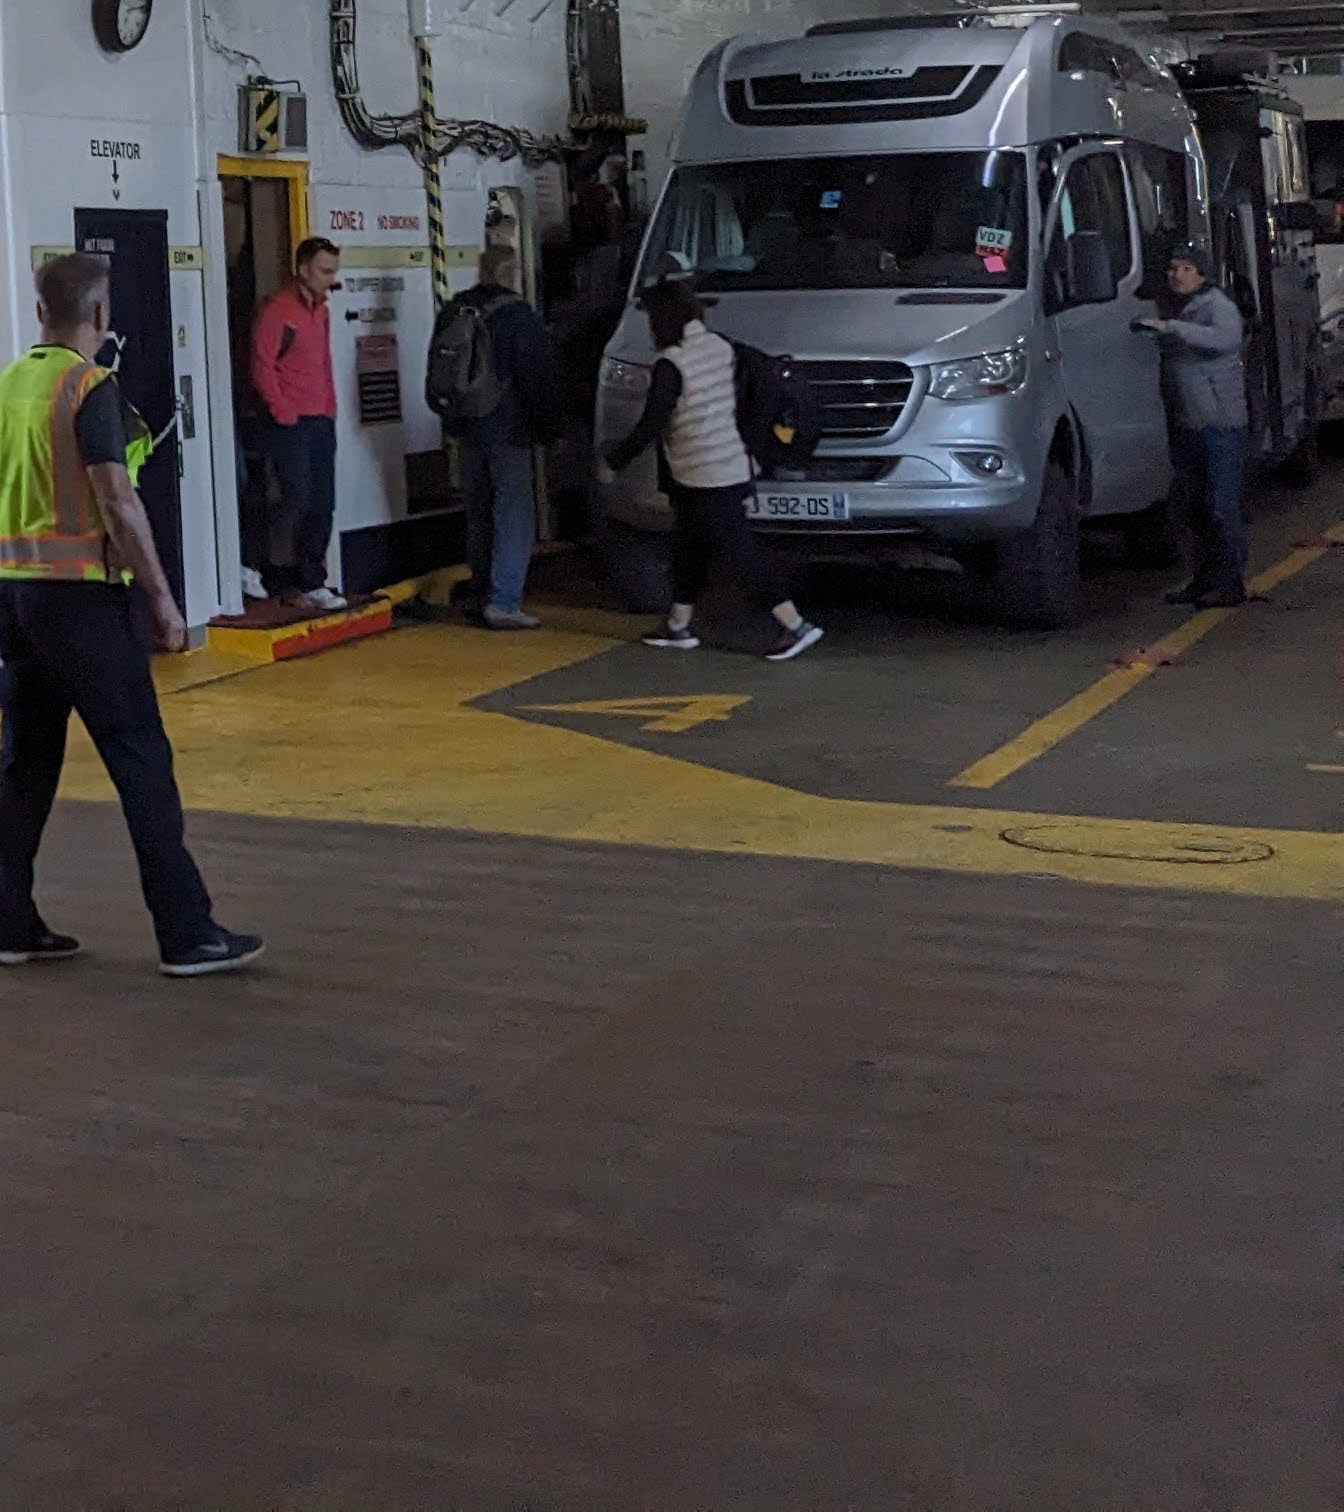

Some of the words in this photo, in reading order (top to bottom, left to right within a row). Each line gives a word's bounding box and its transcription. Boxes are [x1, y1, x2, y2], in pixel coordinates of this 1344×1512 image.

[835, 66, 903, 78] strada
[90, 139, 141, 160] ELEVATOR
[329, 210, 357, 230] ZONE
[768, 496, 829, 516] 592-DS
